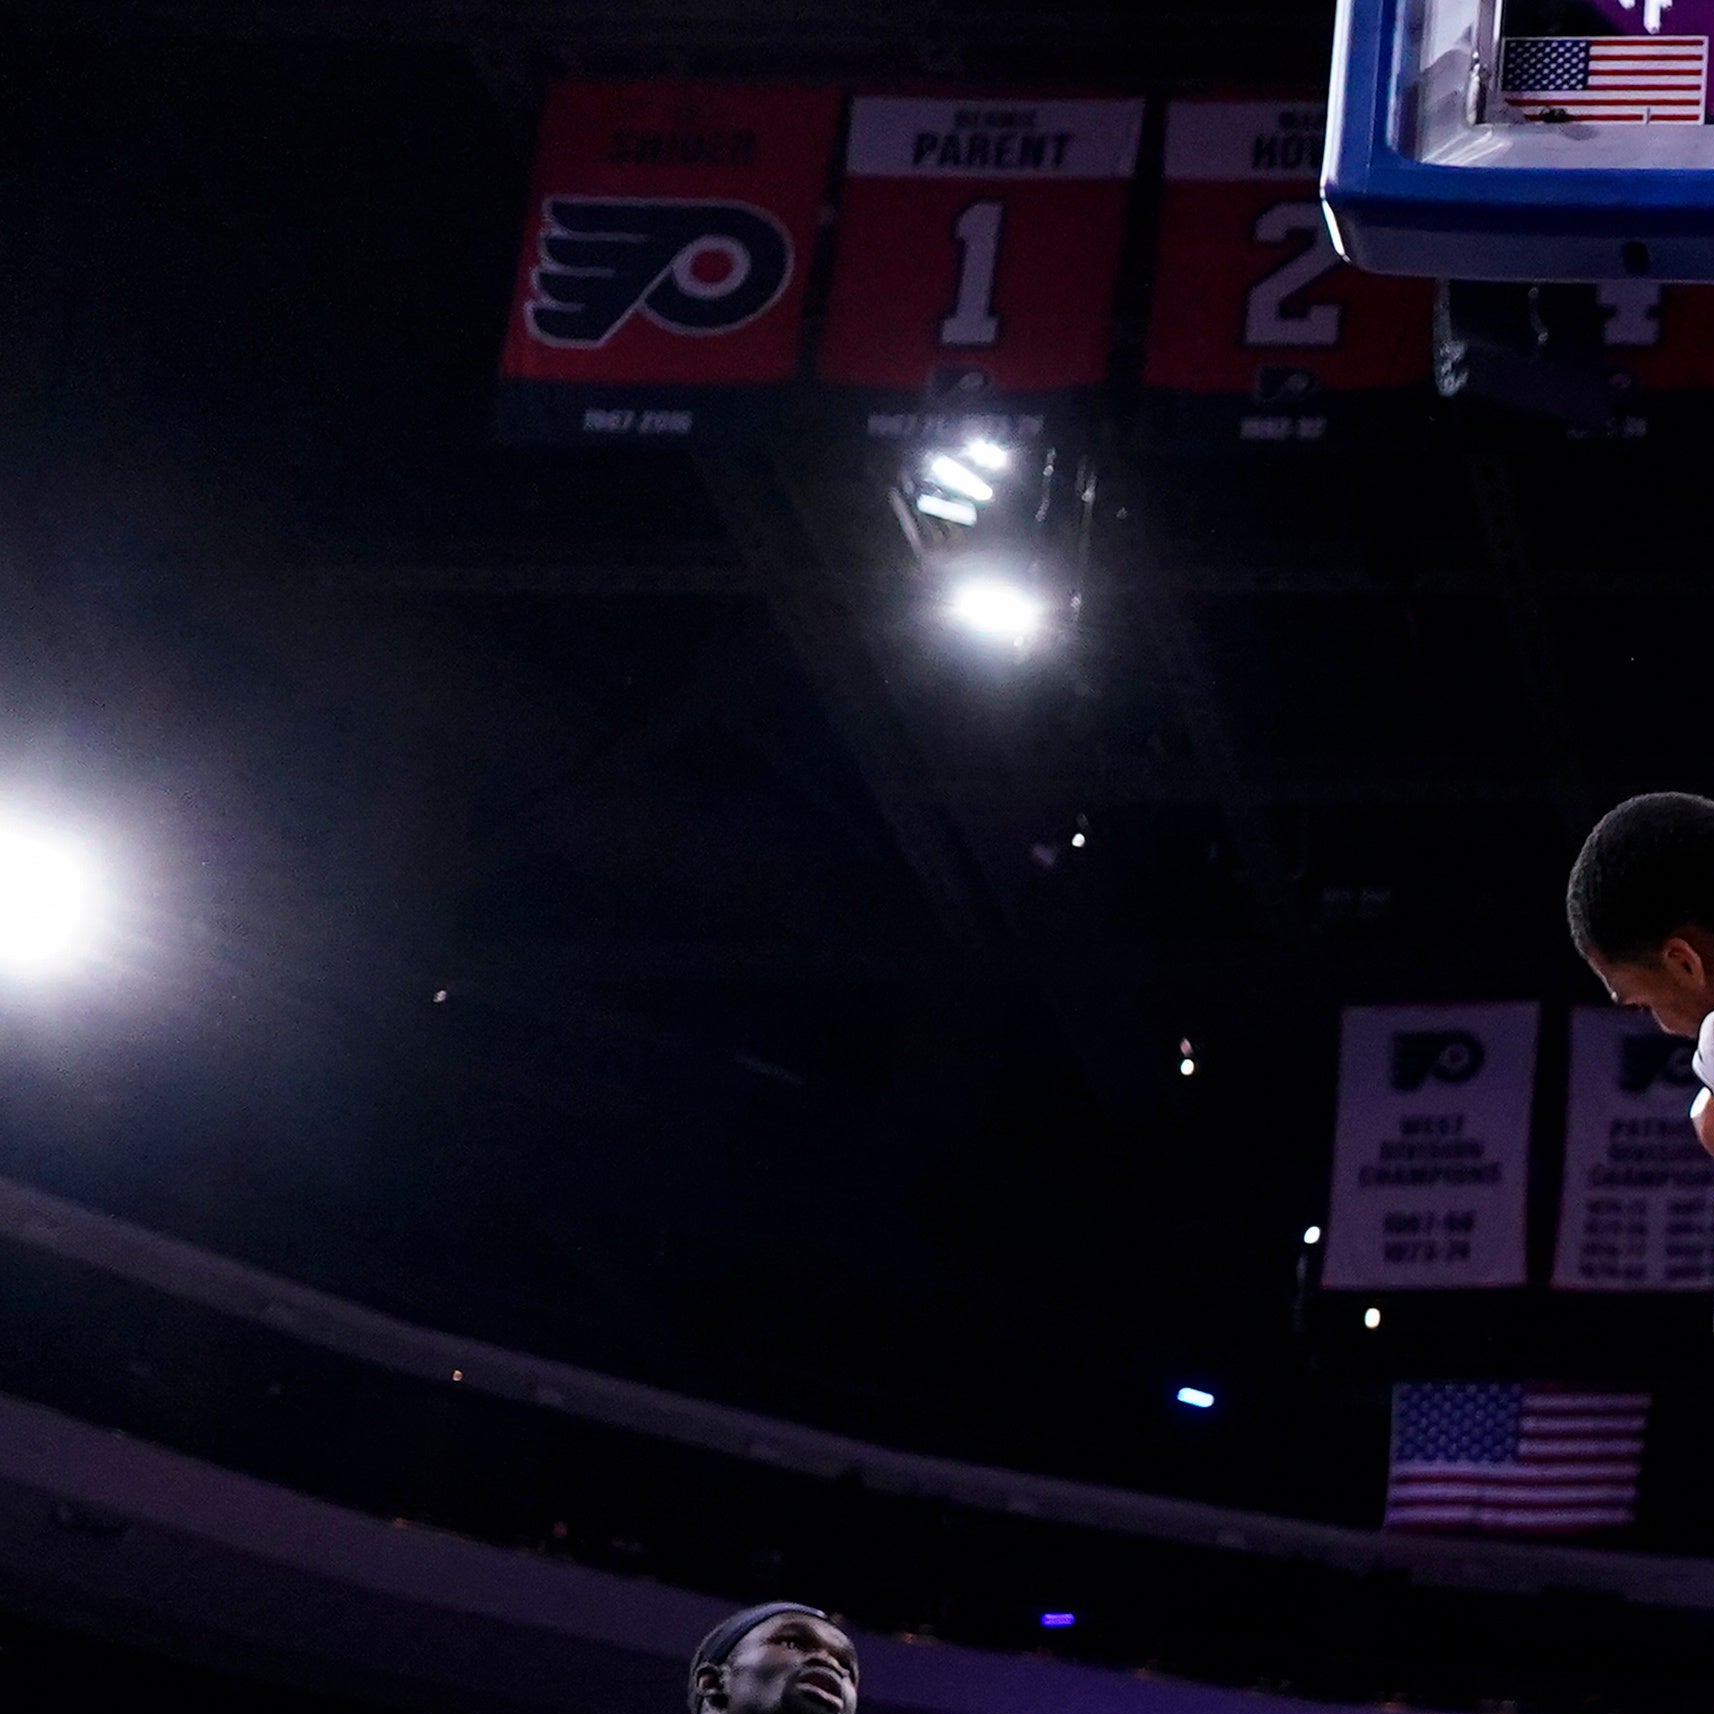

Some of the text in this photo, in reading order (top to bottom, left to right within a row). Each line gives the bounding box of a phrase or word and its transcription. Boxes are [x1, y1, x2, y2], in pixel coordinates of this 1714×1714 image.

[912, 131, 1074, 167] PARENT
[940, 200, 1004, 346] 1
[1244, 201, 1342, 346] 2
